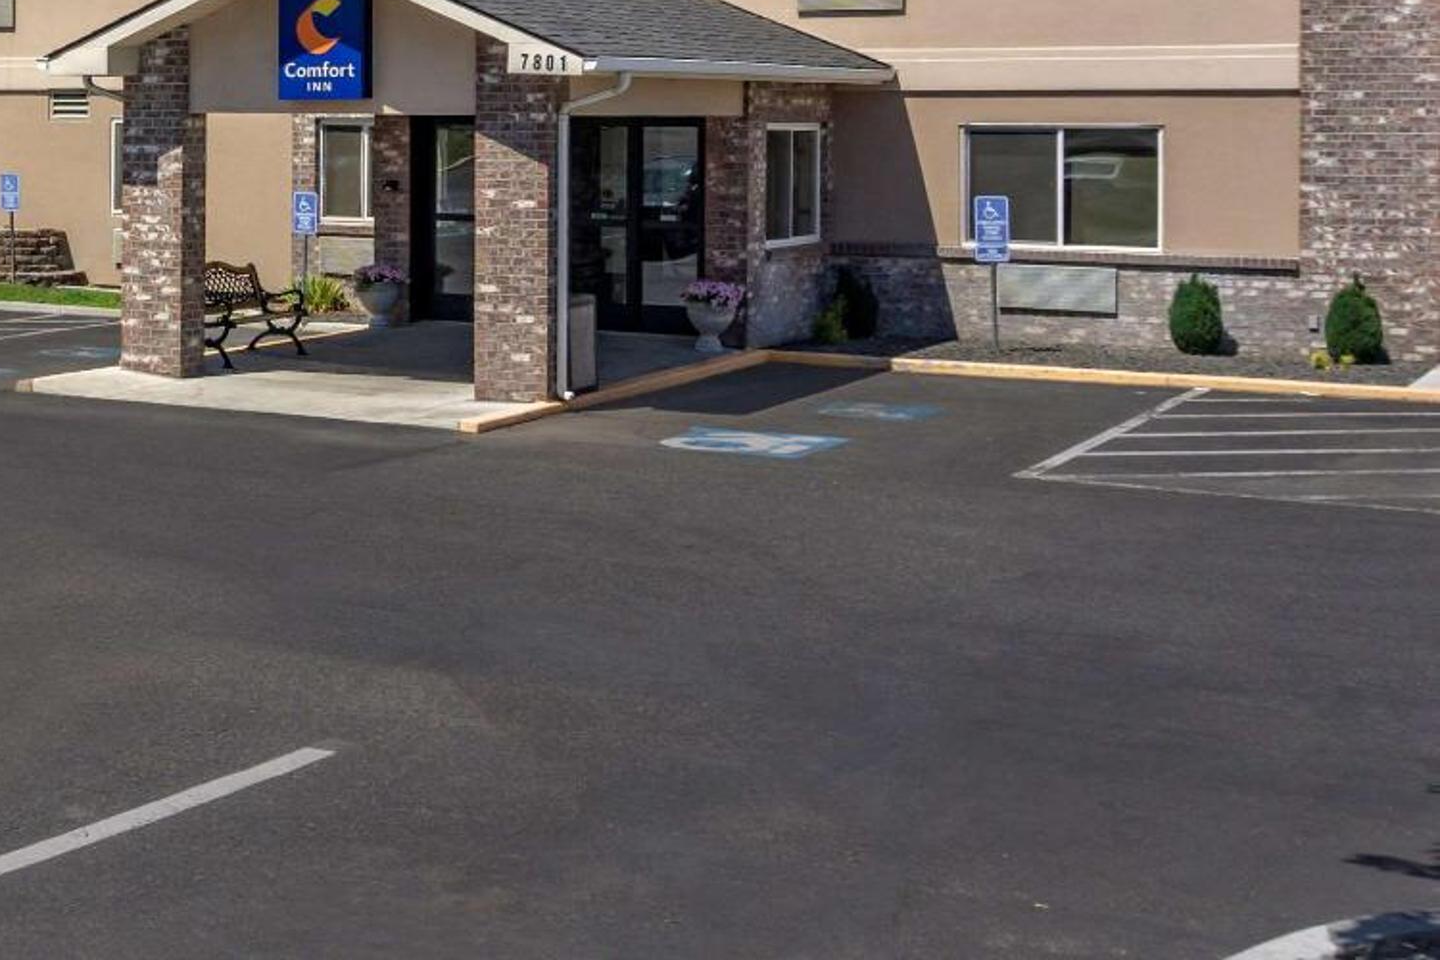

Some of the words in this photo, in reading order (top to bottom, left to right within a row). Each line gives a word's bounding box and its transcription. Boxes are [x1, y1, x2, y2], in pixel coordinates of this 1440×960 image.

[284, 61, 356, 78] Comfort
[521, 53, 567, 72] 7801
[306, 82, 333, 92] INN
